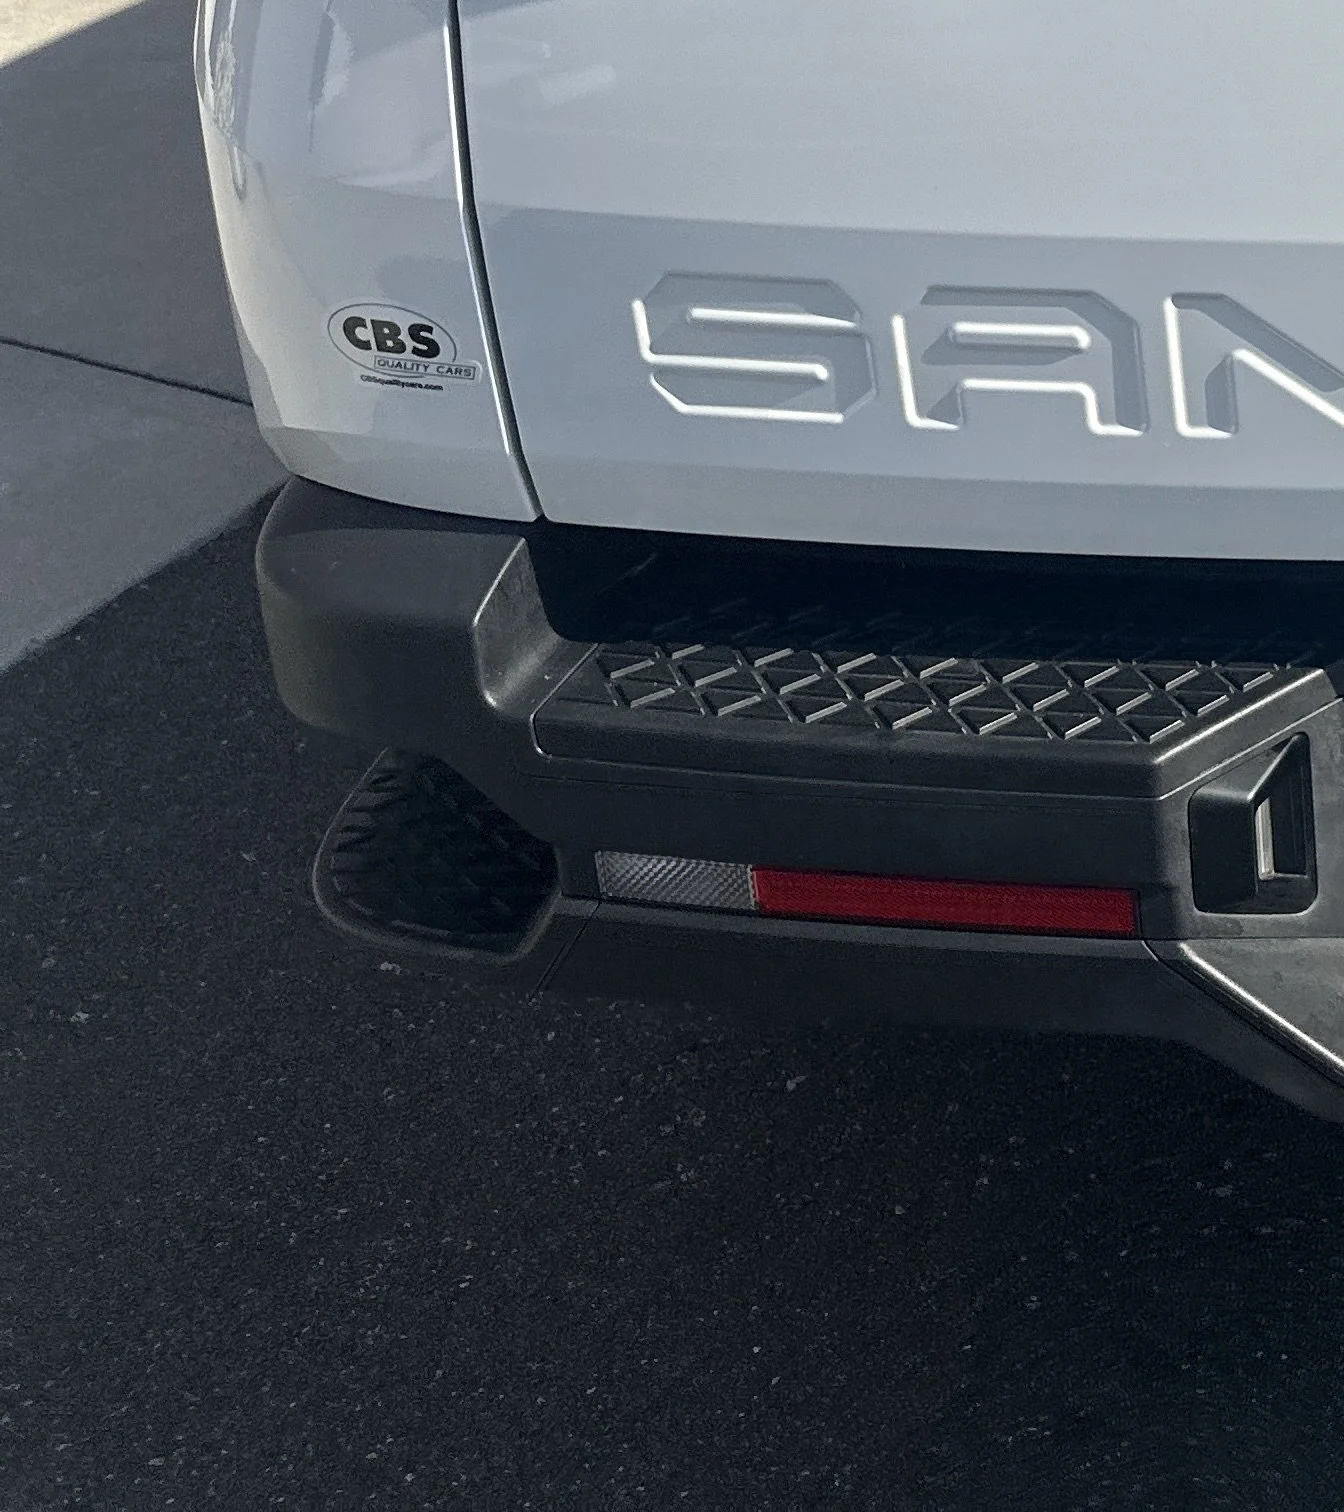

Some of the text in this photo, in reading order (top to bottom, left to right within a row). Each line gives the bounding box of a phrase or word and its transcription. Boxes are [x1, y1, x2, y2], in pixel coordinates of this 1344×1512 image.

[342, 316, 441, 359] CBS
[377, 359, 474, 378] QUALITY CARS
